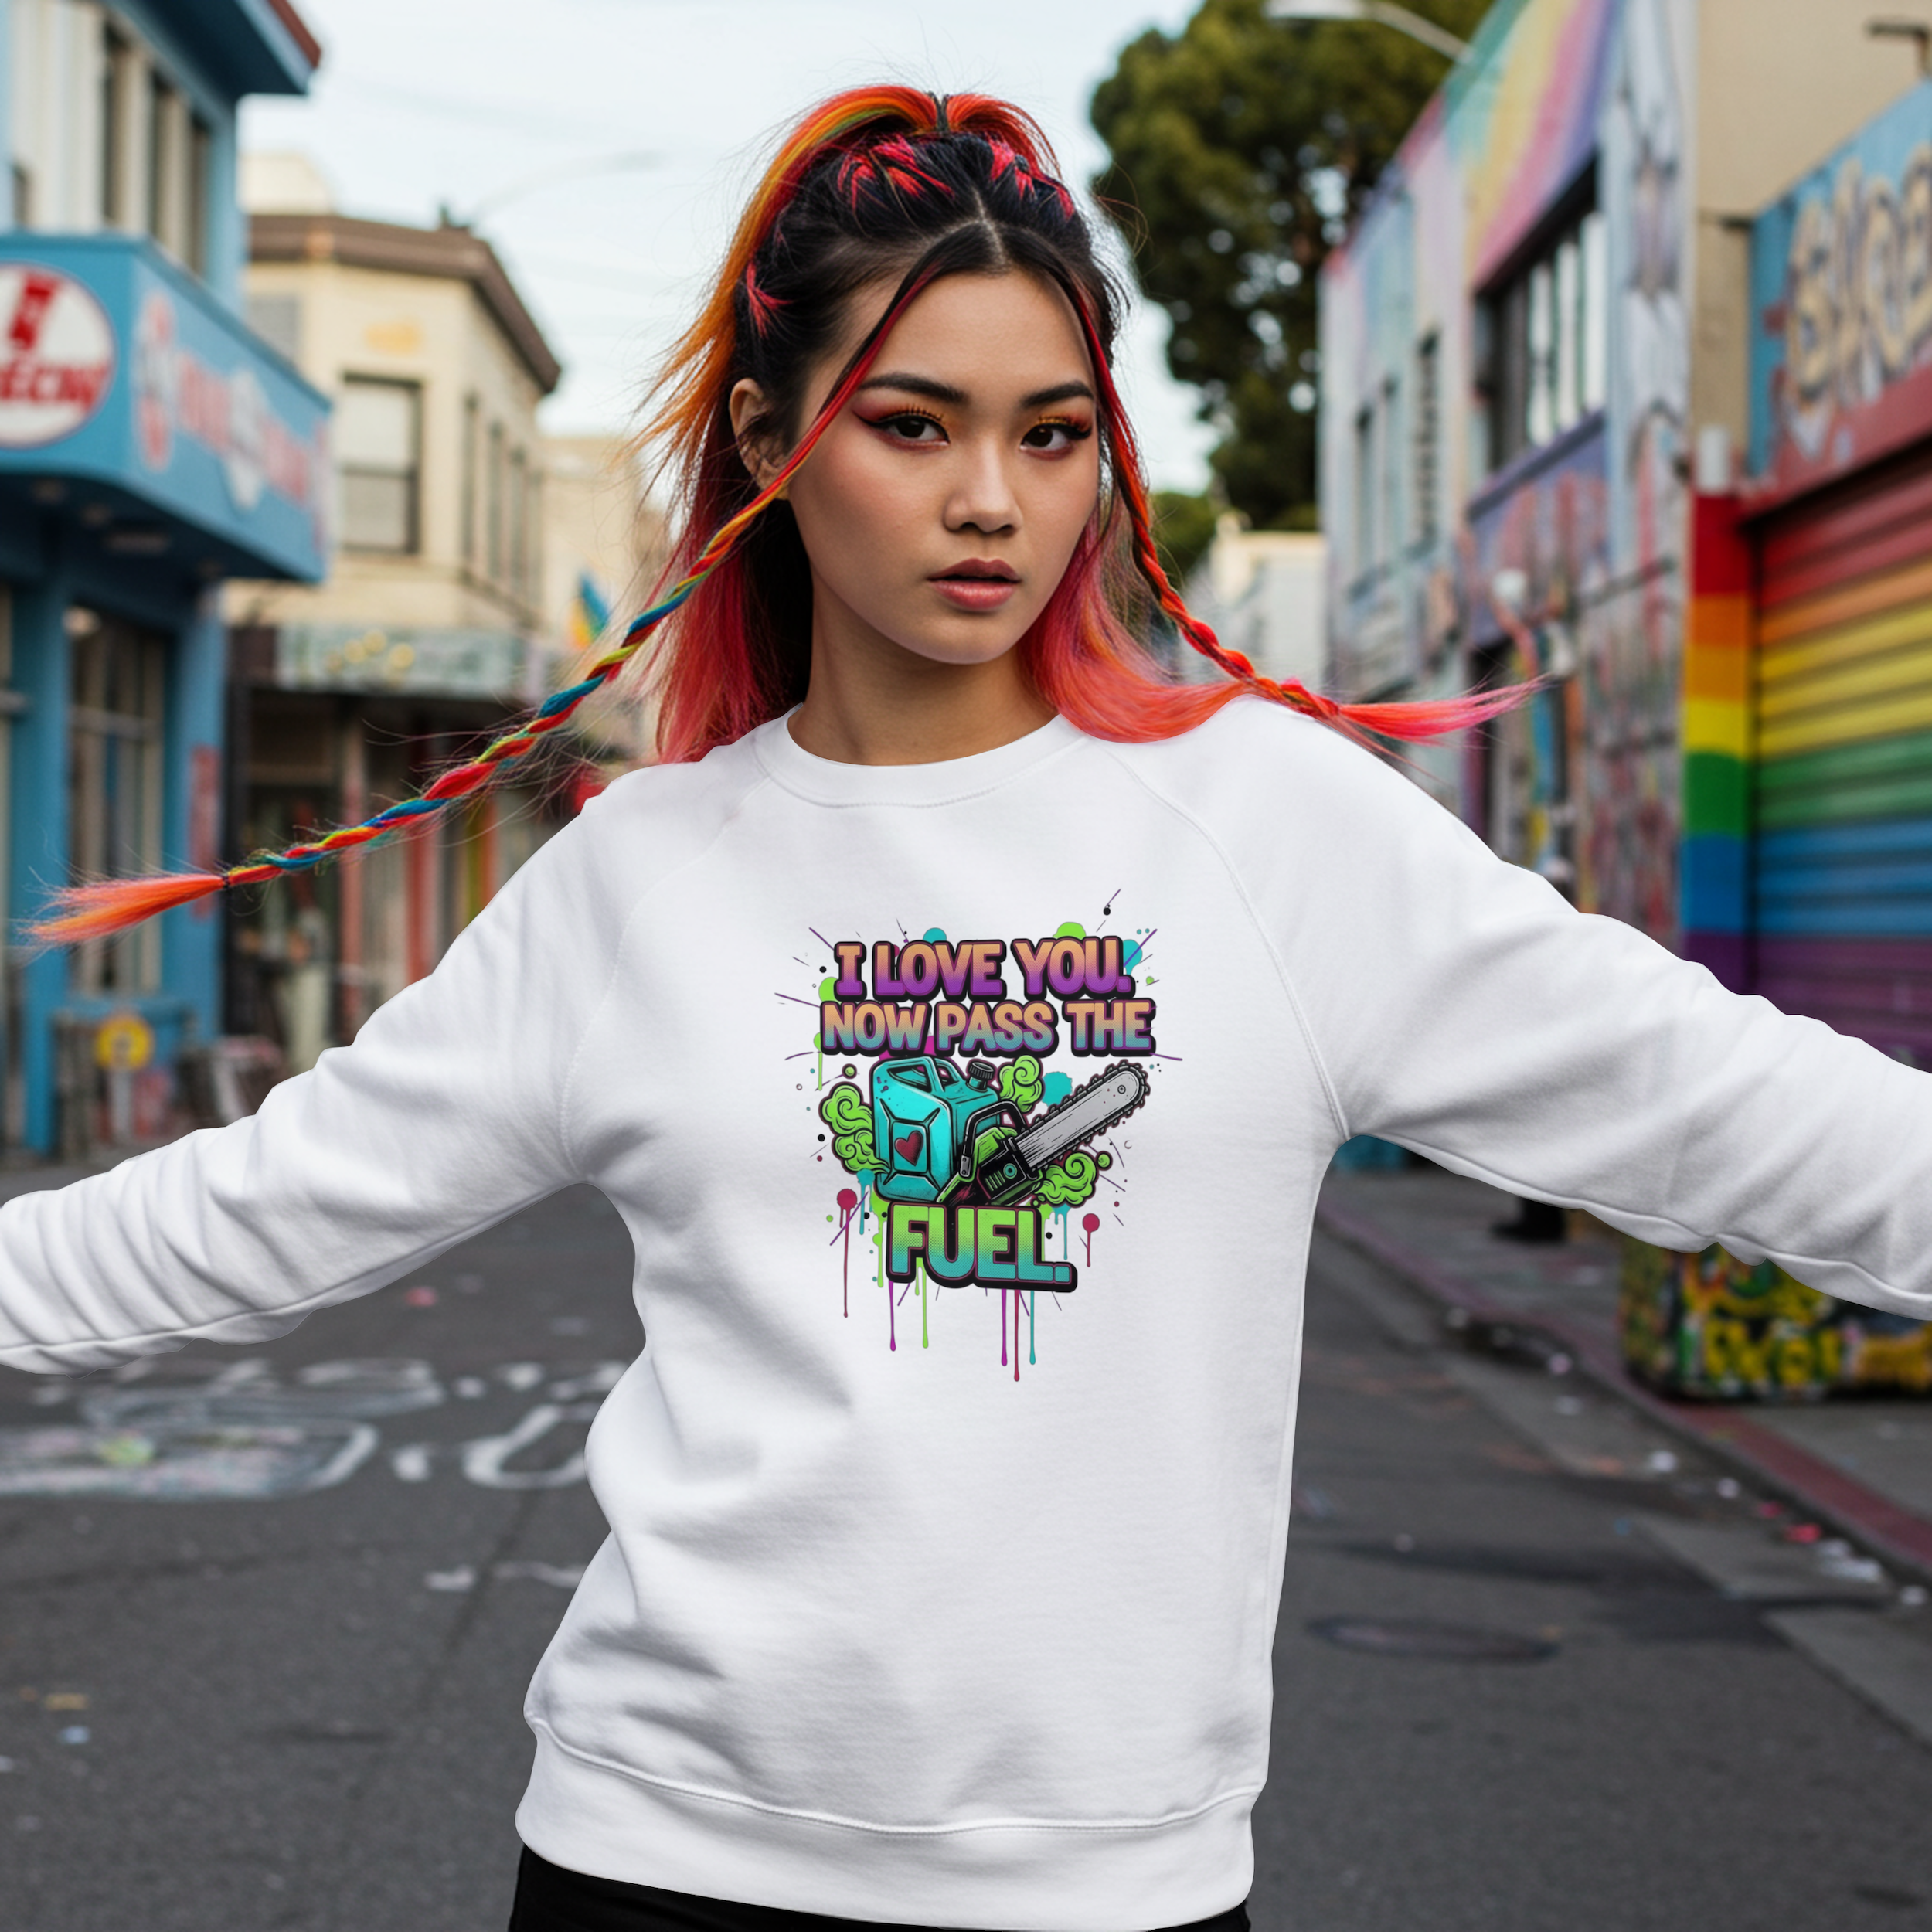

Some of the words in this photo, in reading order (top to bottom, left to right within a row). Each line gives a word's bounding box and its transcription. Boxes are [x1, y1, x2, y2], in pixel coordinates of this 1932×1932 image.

[834, 941, 866, 999] I
[872, 940, 1005, 1000] LOVE
[1012, 937, 1134, 999] YOU.
[821, 1001, 930, 1056] NOW
[933, 1000, 1058, 1056] PASS
[1063, 998, 1155, 1056] THE
[886, 1203, 1077, 1292] FUEL.
